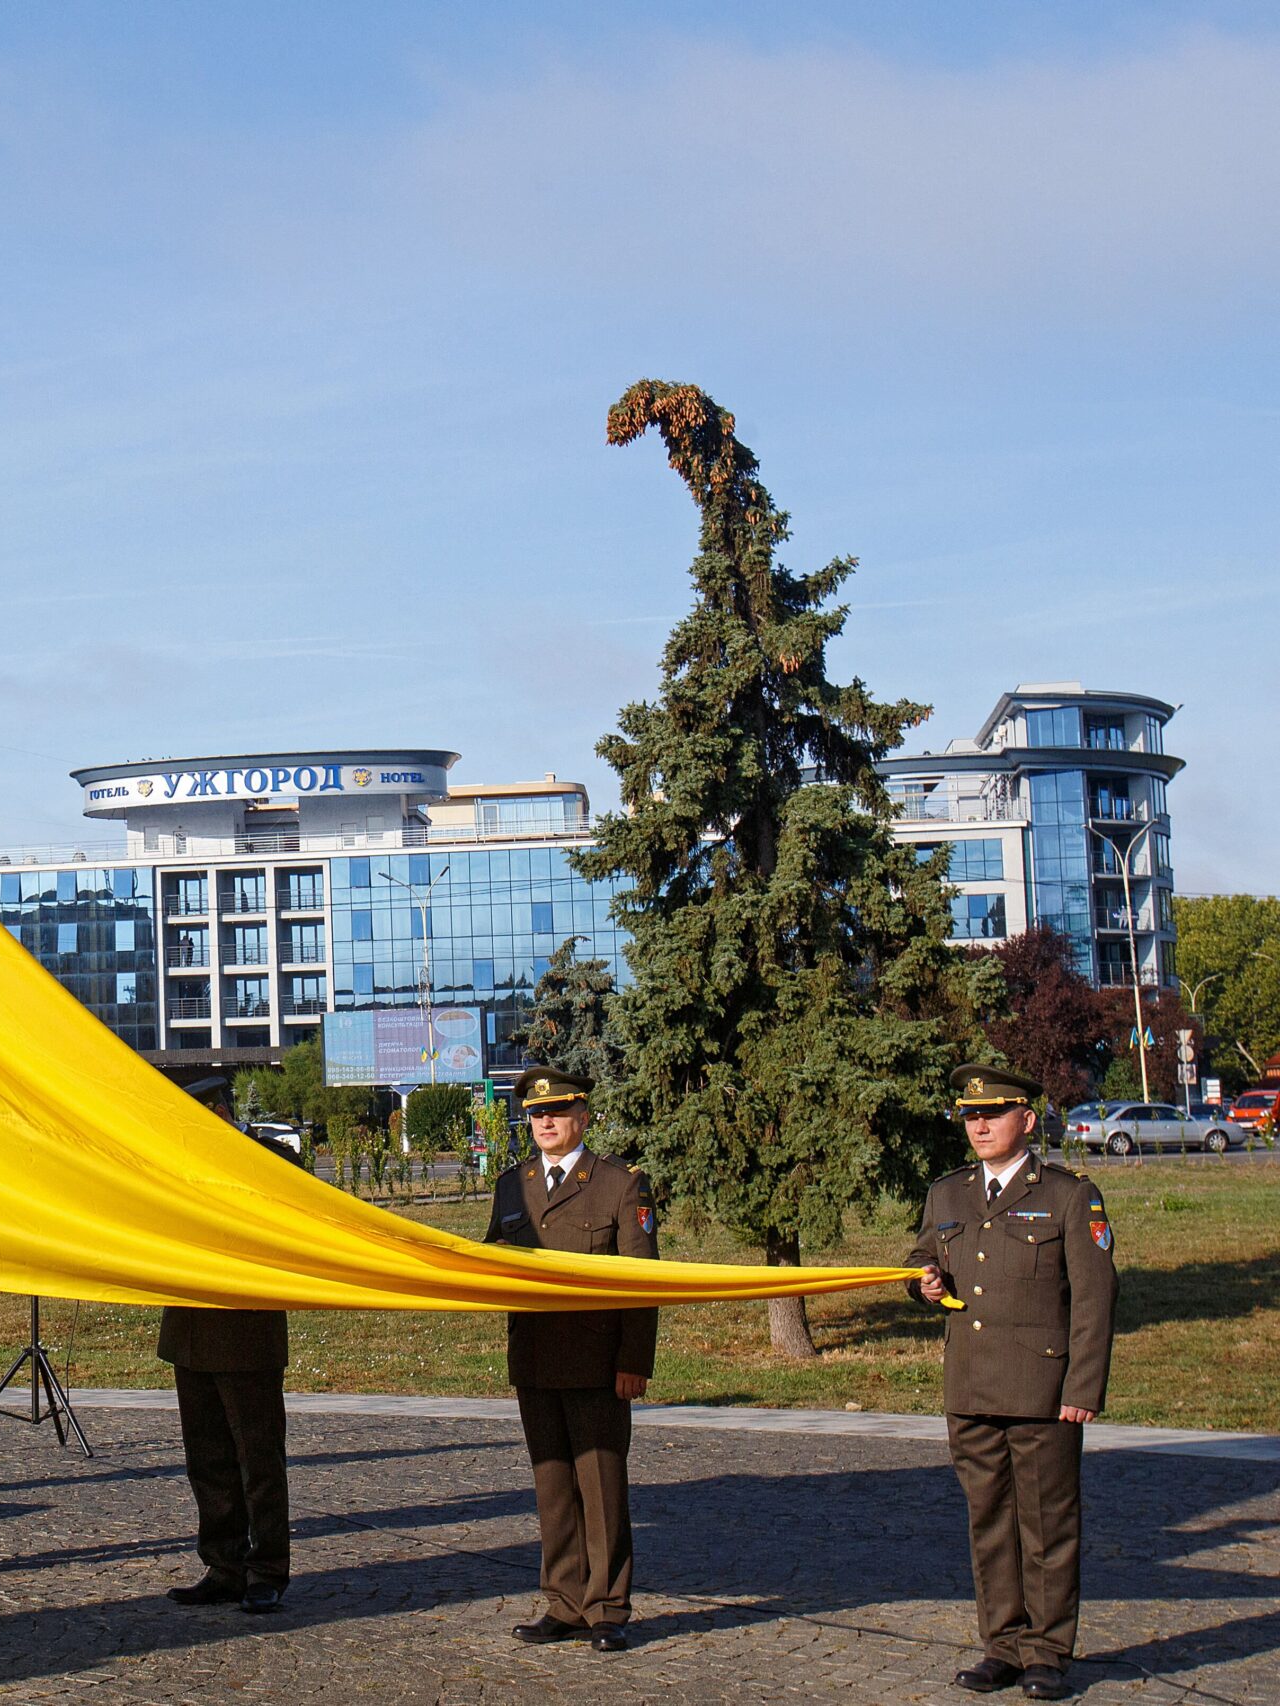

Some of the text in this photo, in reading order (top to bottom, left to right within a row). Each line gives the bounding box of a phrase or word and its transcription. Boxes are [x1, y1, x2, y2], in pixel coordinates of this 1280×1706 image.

[89, 764, 345, 801] ГОТЕЛЬ УЖГОРОД
[379, 772, 425, 784] HOTEL
